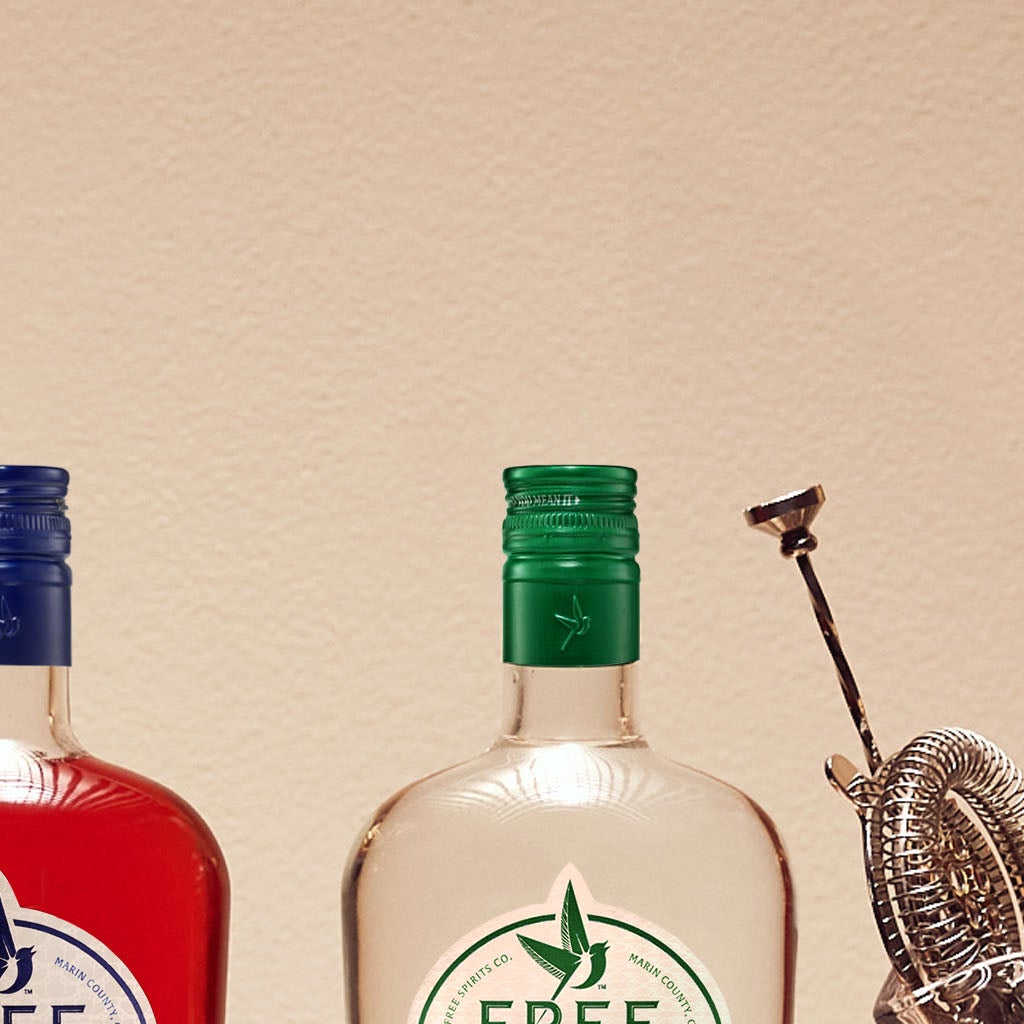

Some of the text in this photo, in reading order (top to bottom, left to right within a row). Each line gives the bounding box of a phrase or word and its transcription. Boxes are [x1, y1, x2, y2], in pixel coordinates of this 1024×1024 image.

[562, 494, 574, 506] IT
[54, 956, 87, 982] MARIN
[457, 963, 492, 998] SPIRITS
[493, 954, 513, 968] CO.
[629, 953, 662, 978] MARIN
